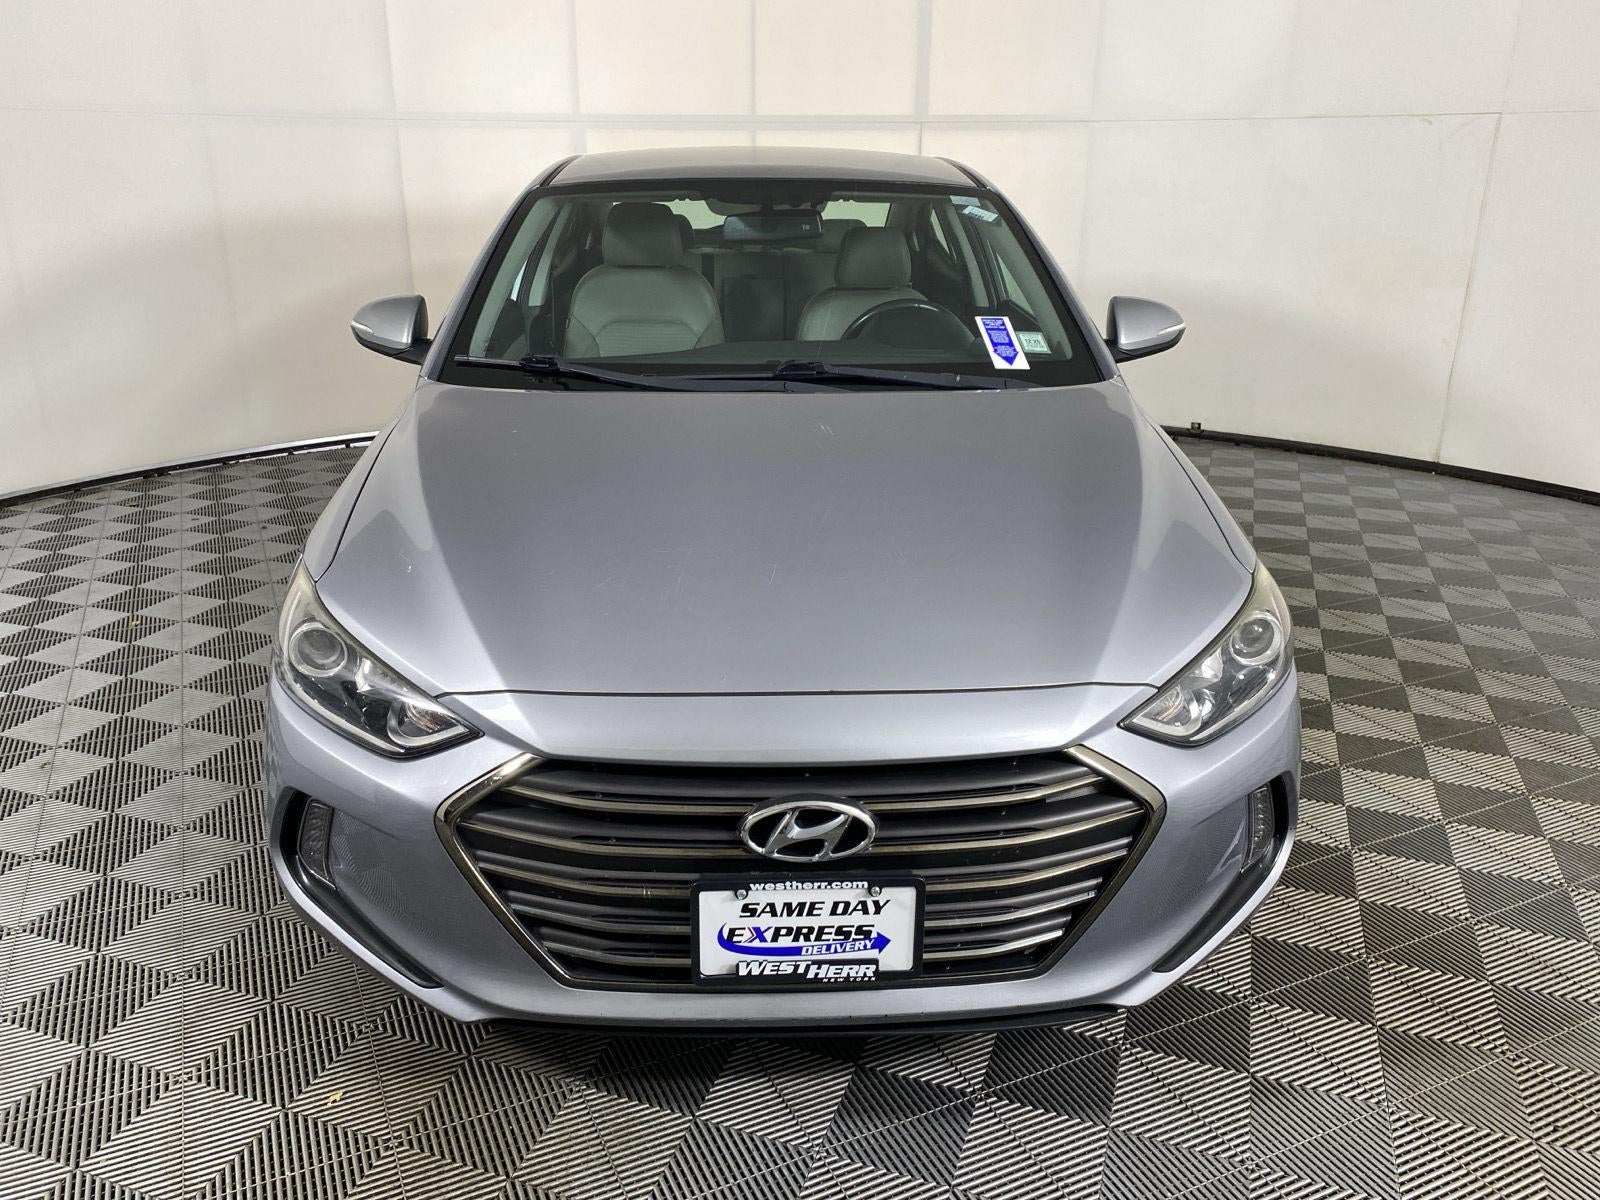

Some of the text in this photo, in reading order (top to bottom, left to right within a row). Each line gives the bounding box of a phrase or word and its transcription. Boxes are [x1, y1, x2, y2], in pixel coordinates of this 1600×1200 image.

[749, 881, 868, 890] westherr.com
[739, 899, 891, 918] SAME DAY
[726, 924, 875, 943] EXPRESS
[801, 939, 875, 956] DELIVERY
